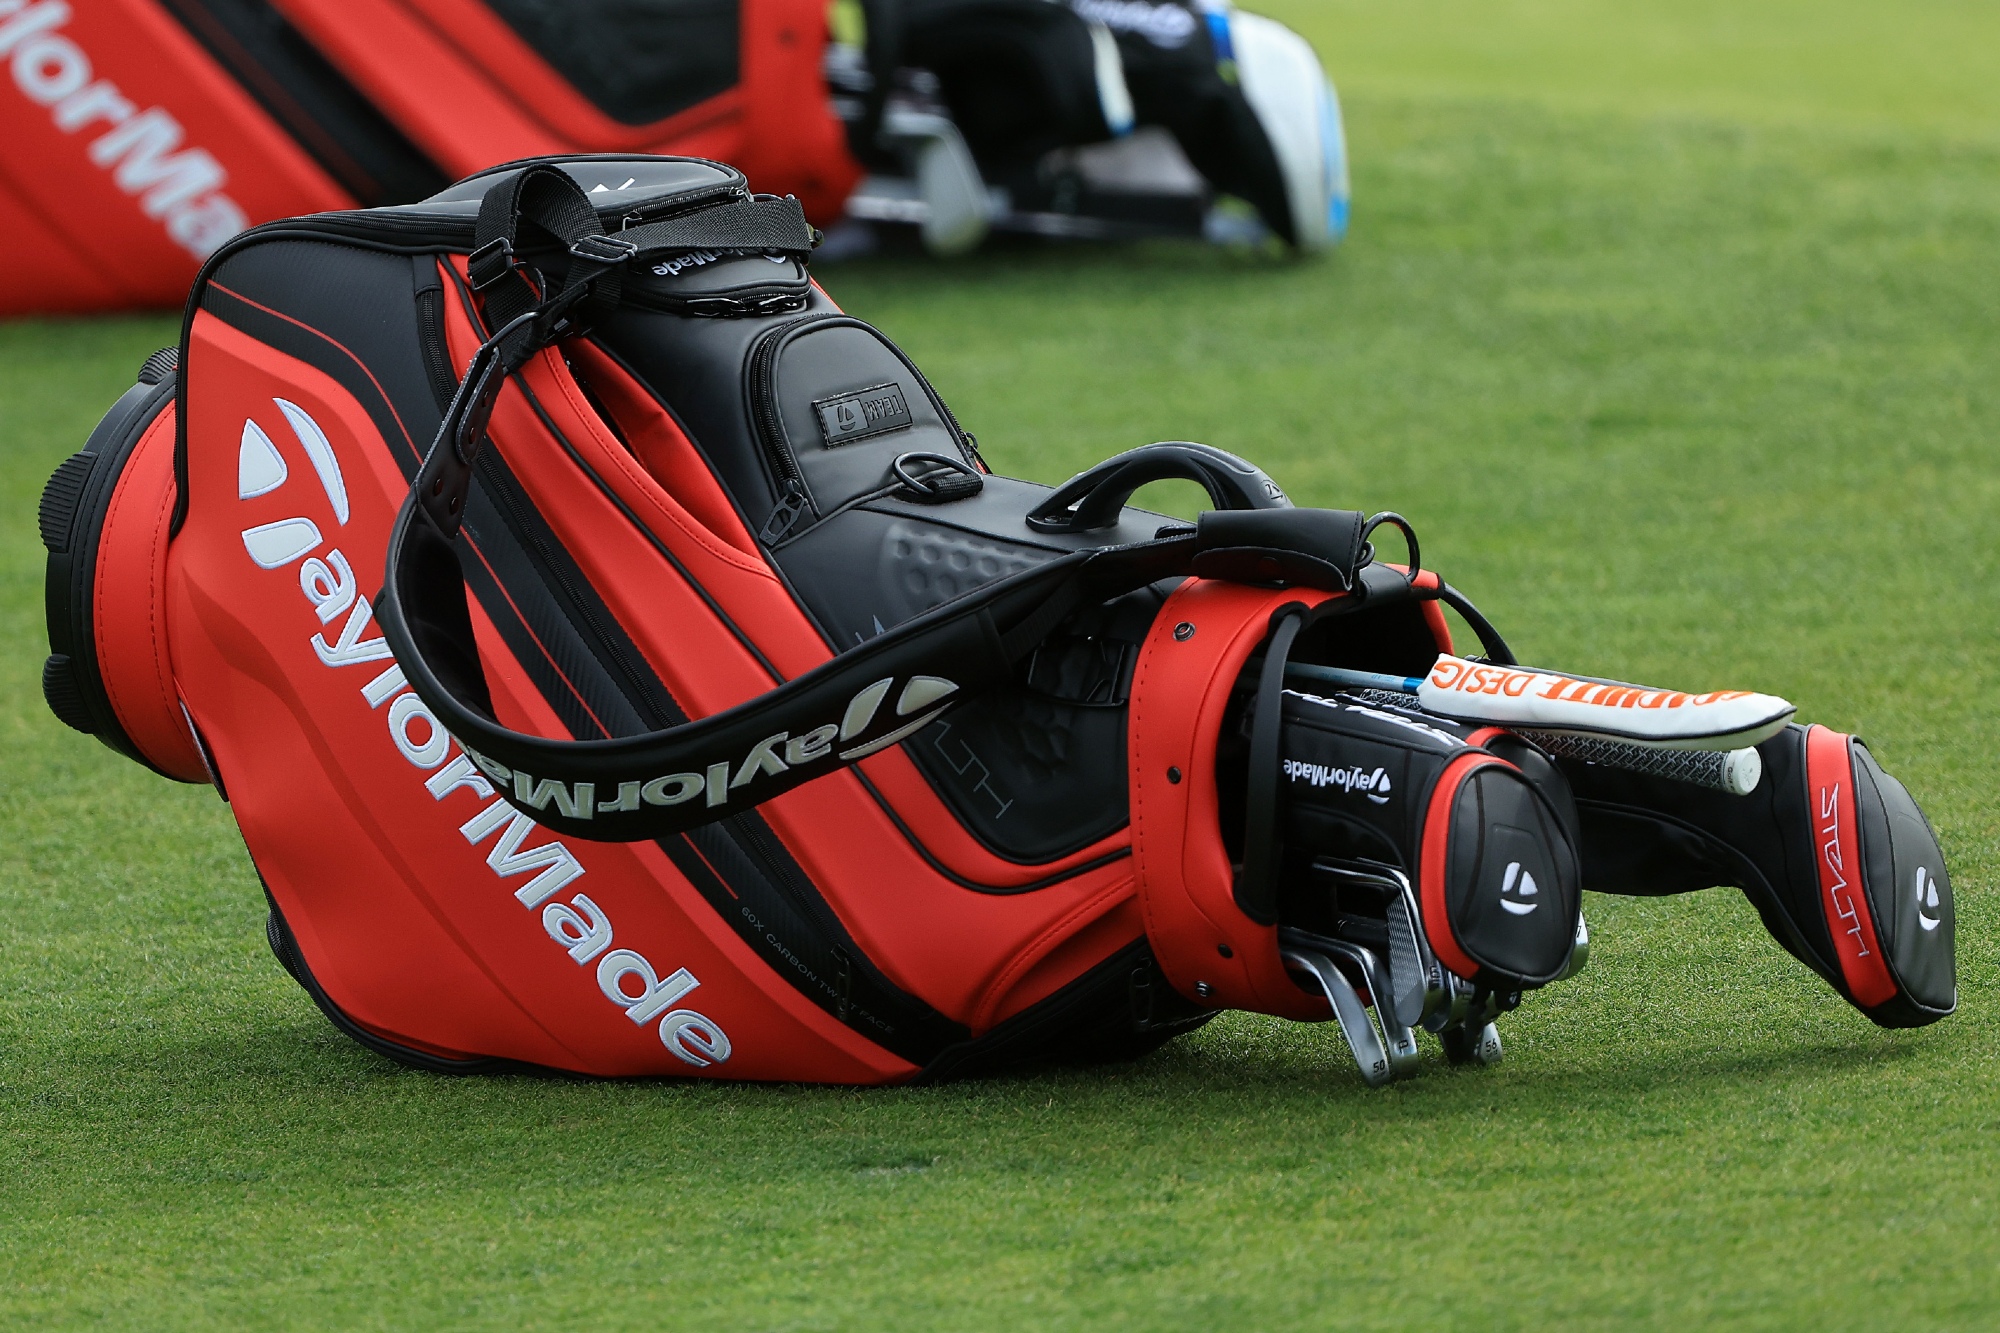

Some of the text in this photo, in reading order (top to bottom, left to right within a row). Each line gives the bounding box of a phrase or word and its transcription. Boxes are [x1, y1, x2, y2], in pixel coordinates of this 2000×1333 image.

[865, 395, 904, 421] TEAM
[238, 397, 733, 1067] TaylorMade
[1283, 759, 1392, 805] TaylorMade
[740, 906, 896, 1035] 60X CARBON TWST FACE
[1485, 1038, 1497, 1053] 56
[1373, 1059, 1386, 1073] 50
